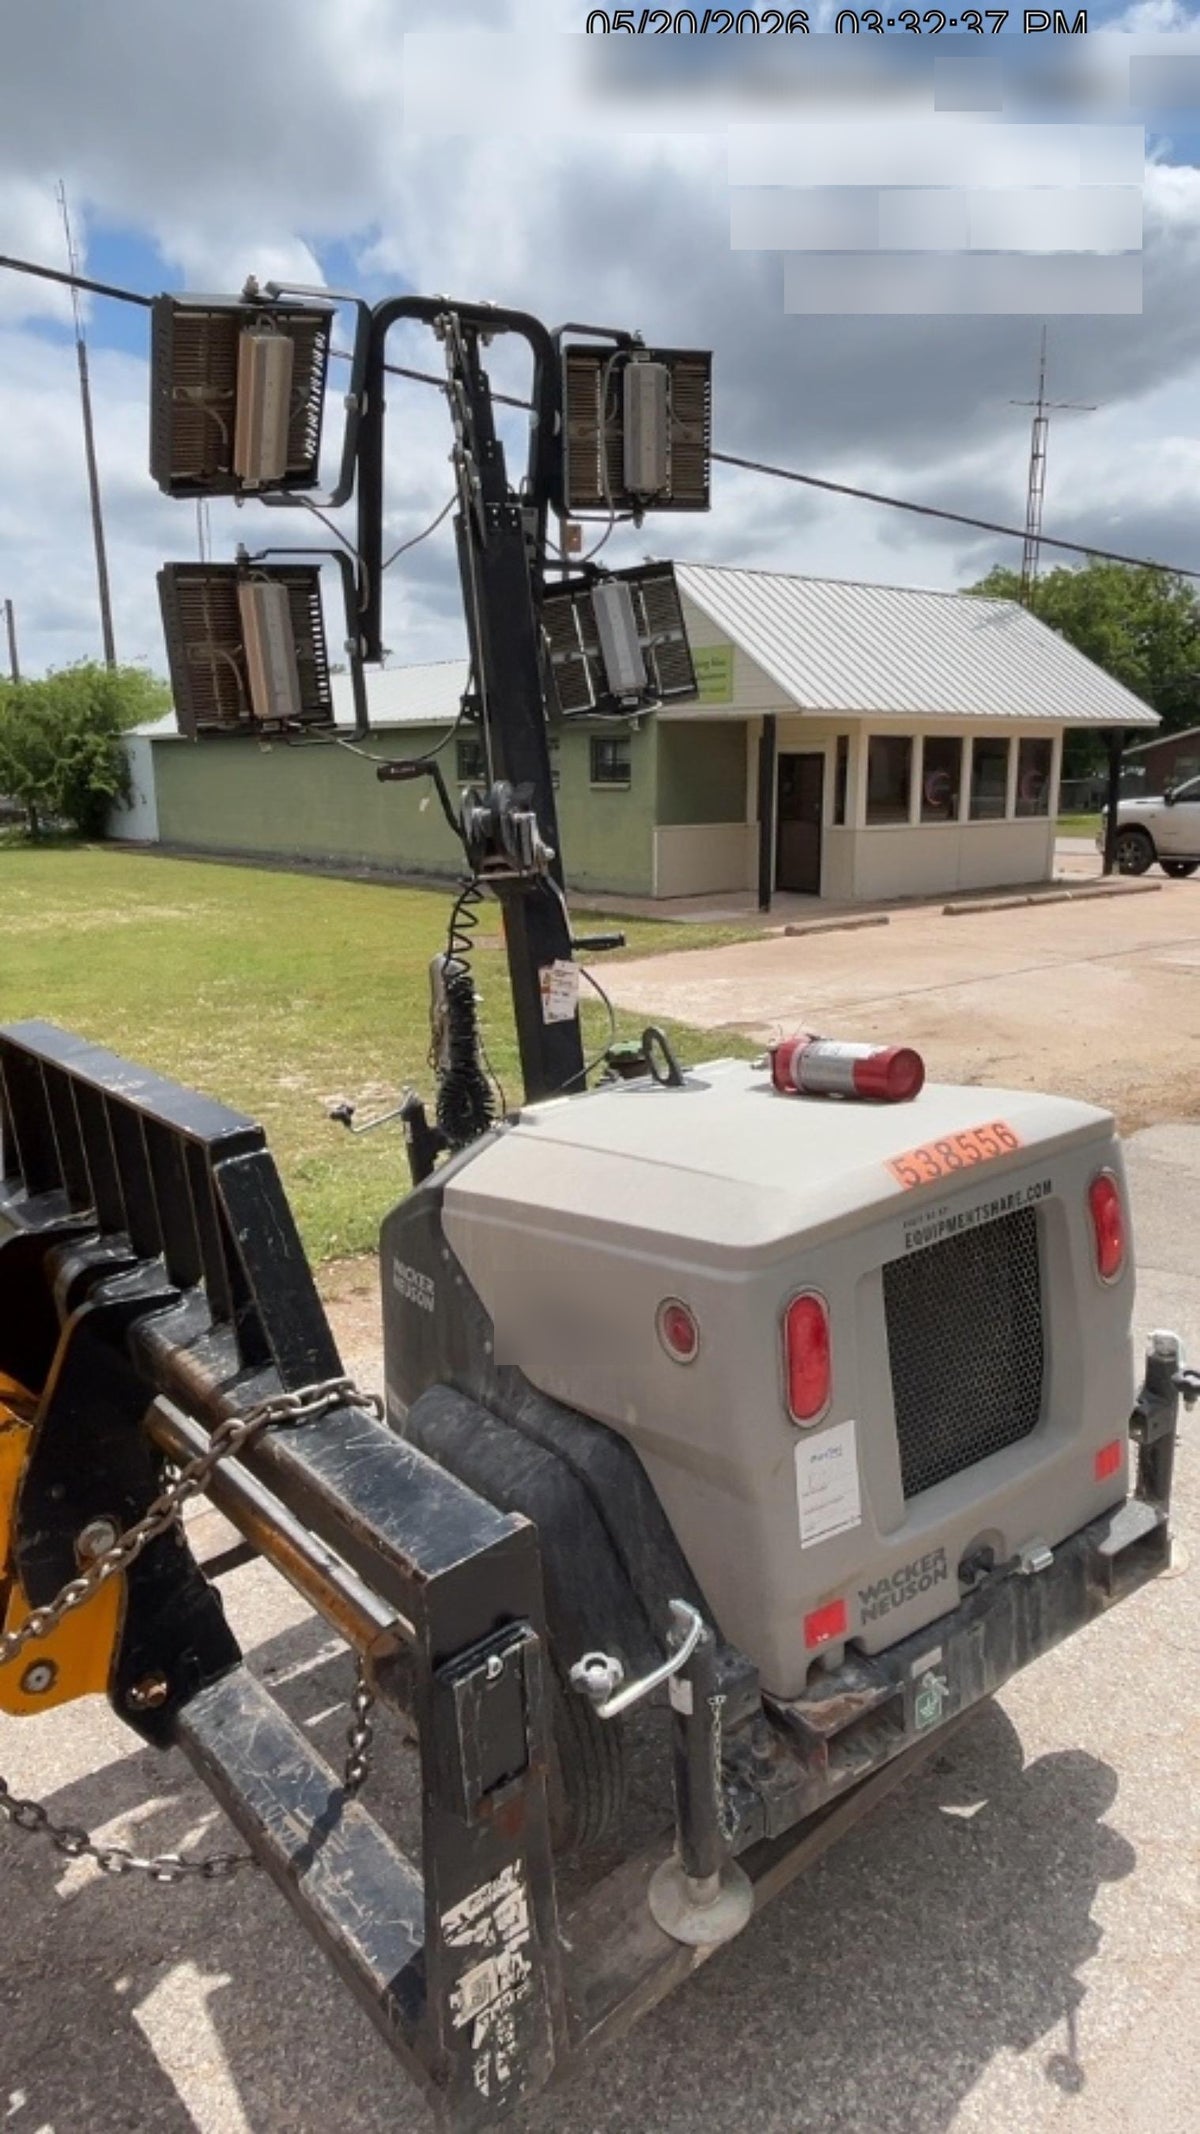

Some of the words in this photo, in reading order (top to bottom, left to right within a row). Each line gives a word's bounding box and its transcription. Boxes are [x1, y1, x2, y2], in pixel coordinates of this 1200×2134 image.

[894, 1122, 1018, 1186] 538556
[904, 1179, 1053, 1249] EQUIPMENTSHARE.COM
[858, 1547, 946, 1601] WACKER
[861, 1566, 948, 1625] NEUSON
